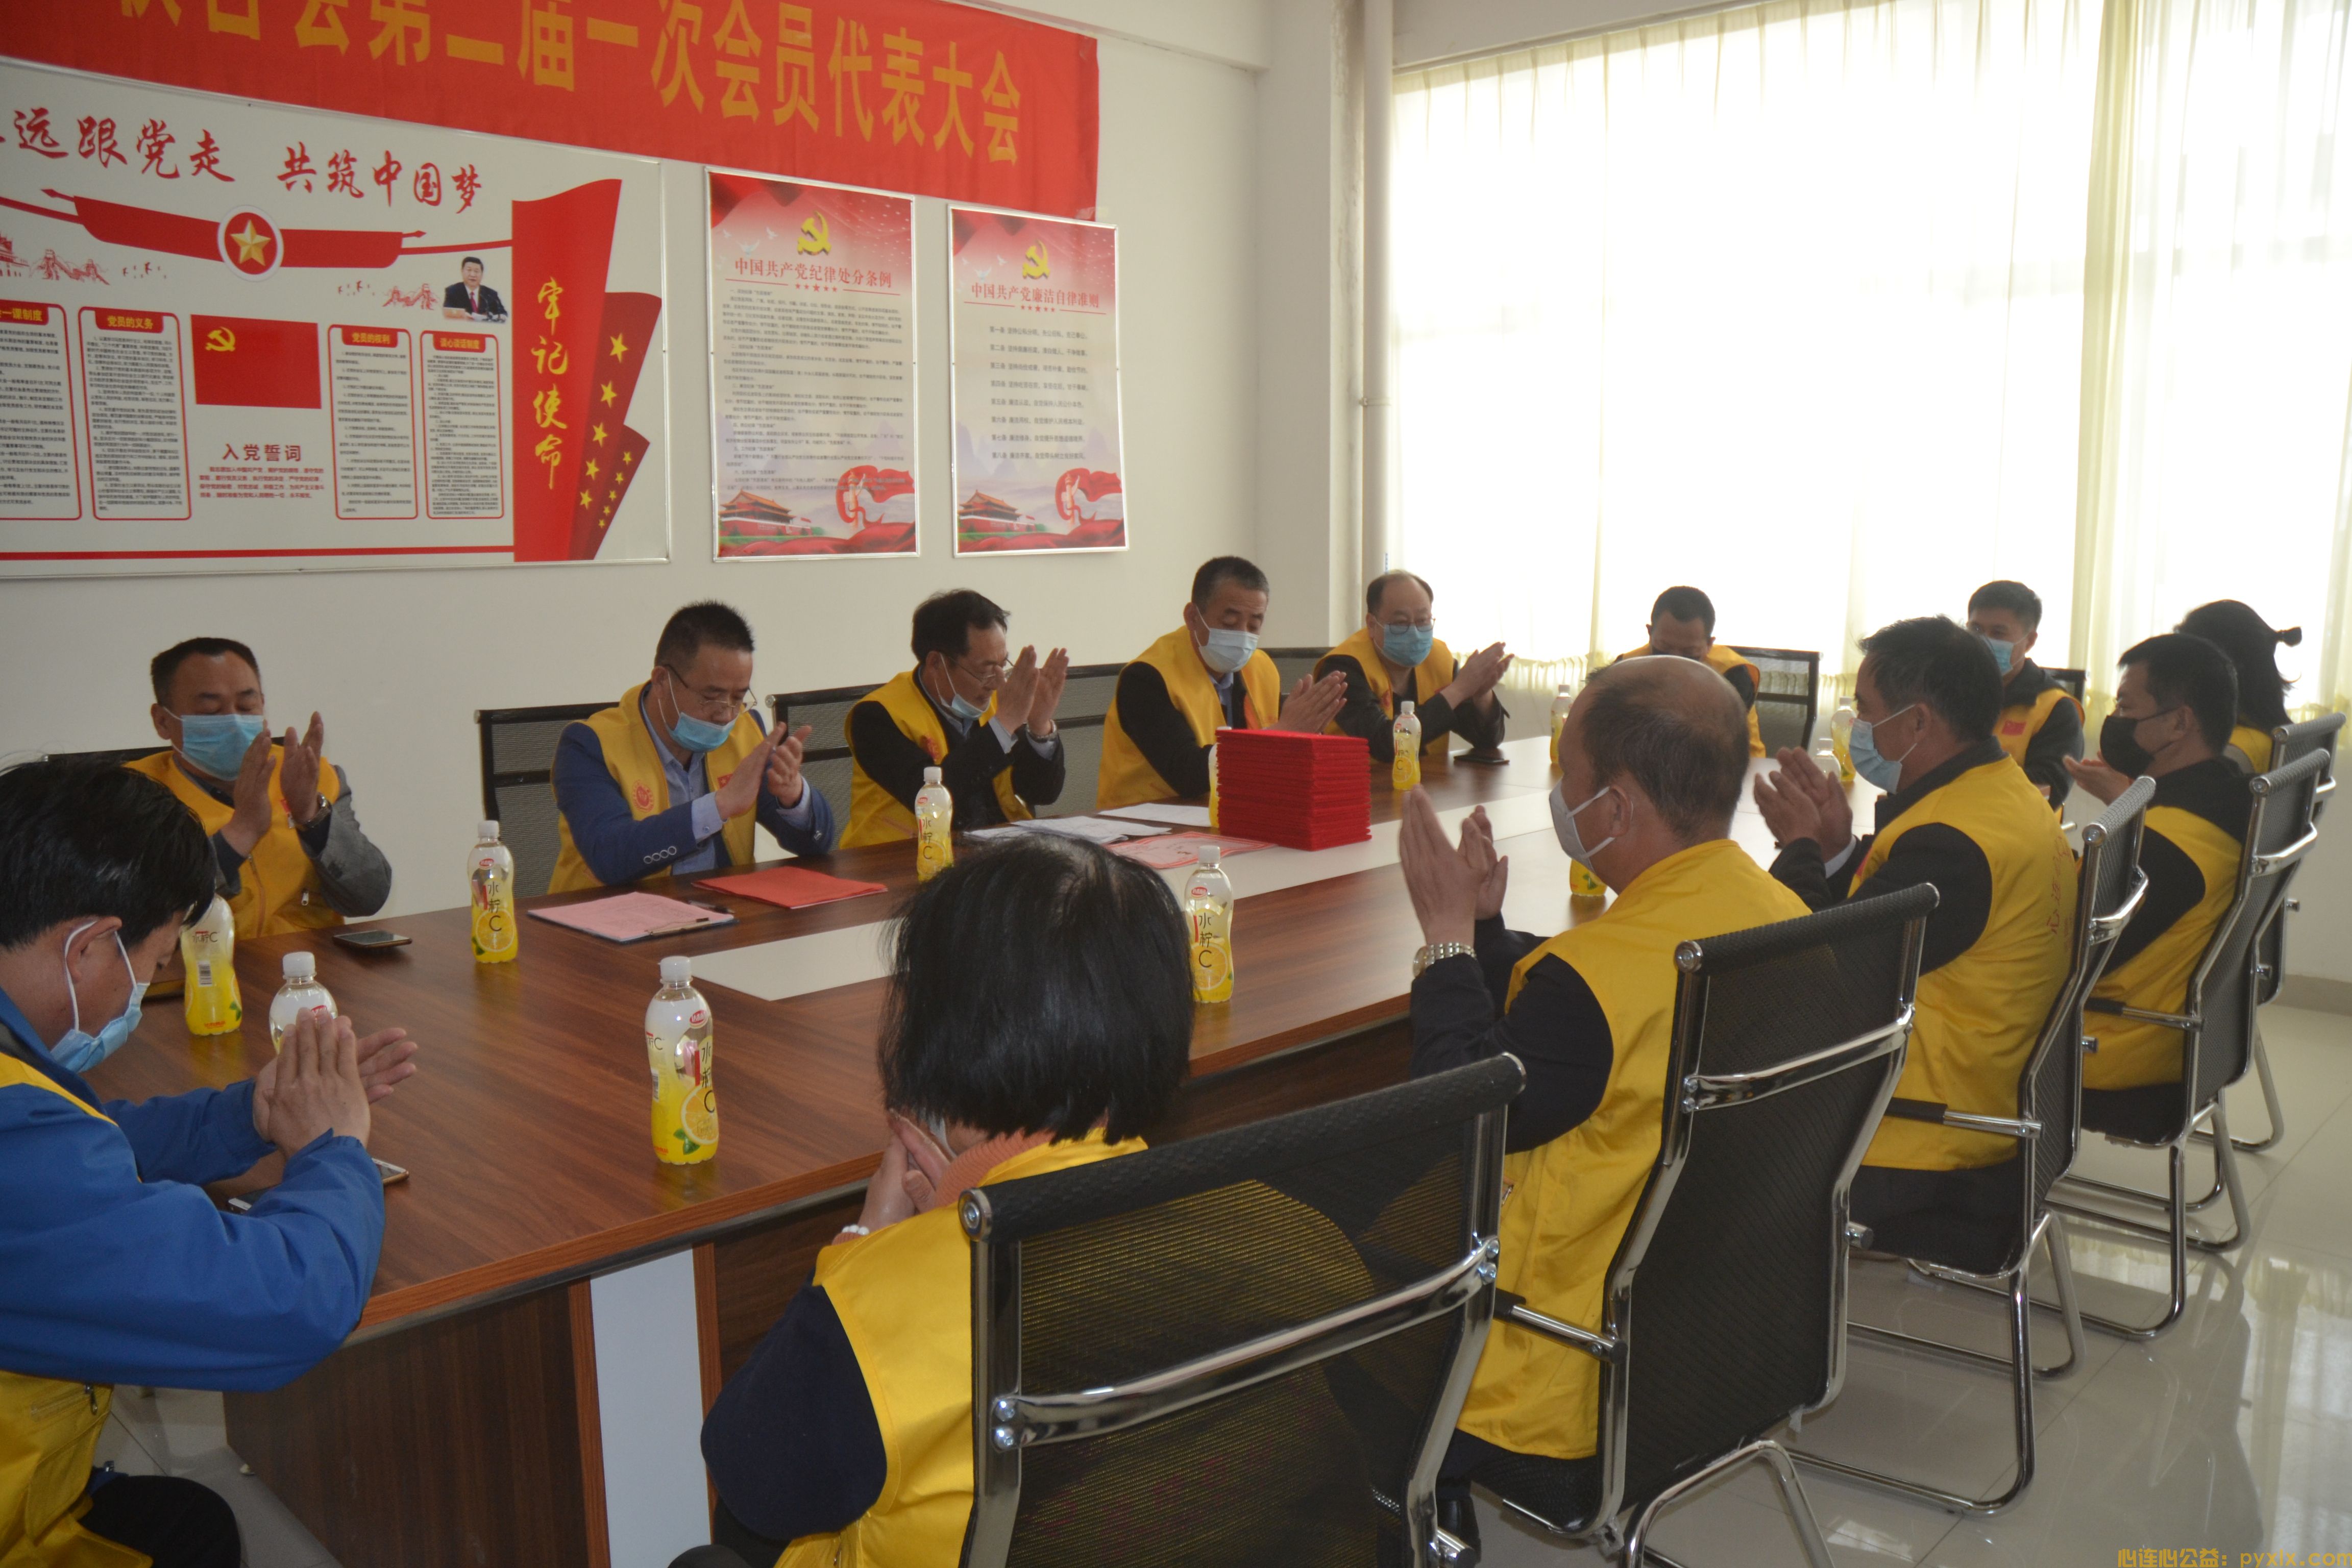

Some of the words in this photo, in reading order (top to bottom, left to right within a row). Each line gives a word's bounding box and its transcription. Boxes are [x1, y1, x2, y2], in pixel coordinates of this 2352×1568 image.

[121, 0, 1021, 166] 第届一次会员代表大会
[0, 107, 235, 182] 远跟党走
[277, 141, 481, 214] 共筑中国梦
[735, 257, 892, 288] 中国共产党纪律处分条例
[971, 282, 1099, 308] 中国共产党廉洁自律准则
[0, 307, 42, 322] 一课制度
[107, 315, 154, 330] 党员的义务
[352, 332, 391, 345] 党员的权利
[531, 277, 568, 489] 牢记使命
[223, 444, 301, 461] 入党誓词
